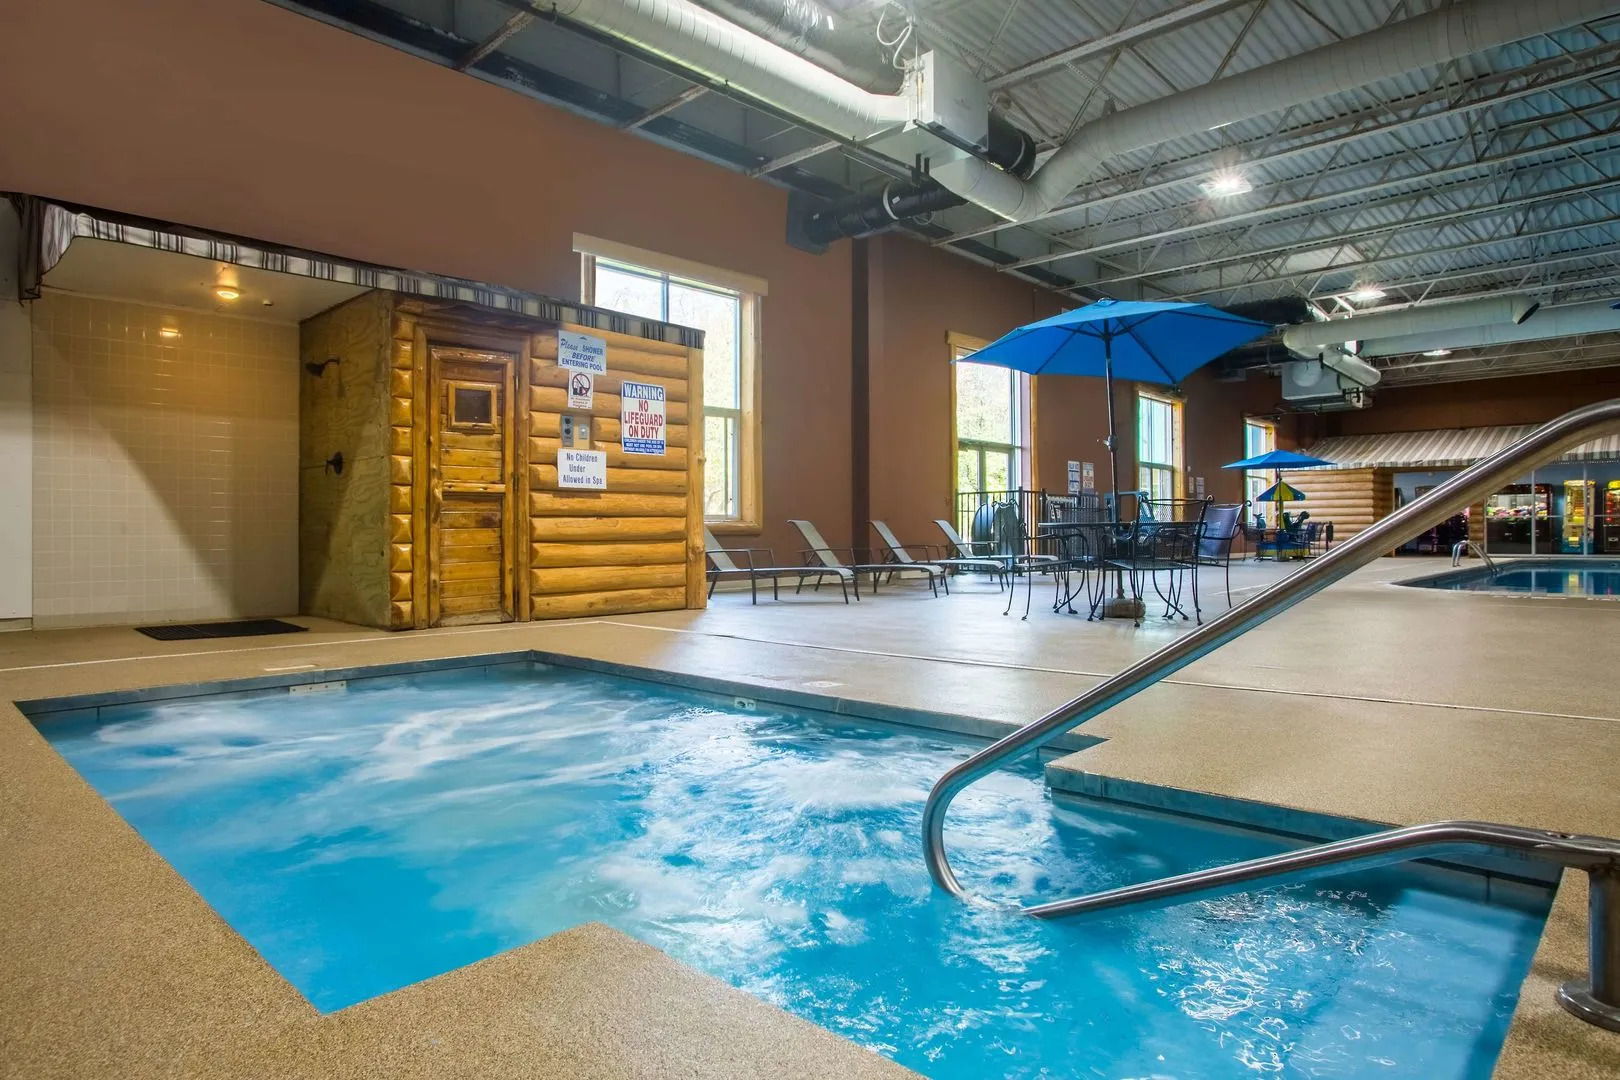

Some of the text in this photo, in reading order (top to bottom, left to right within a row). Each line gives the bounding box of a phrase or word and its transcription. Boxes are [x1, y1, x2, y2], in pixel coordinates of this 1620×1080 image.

[560, 337, 604, 355] Please SHOWER
[571, 352, 595, 362] BEFORE
[562, 358, 603, 371] ENTERING POOL
[624, 384, 663, 400] WARNING
[638, 399, 649, 412] NO
[624, 412, 664, 427] LIFEGUARD
[628, 425, 659, 439] ON DUTY
[566, 453, 597, 462] No Children
[569, 464, 586, 473] Under
[563, 474, 584, 483] Allowed
[593, 476, 603, 485] Spa
